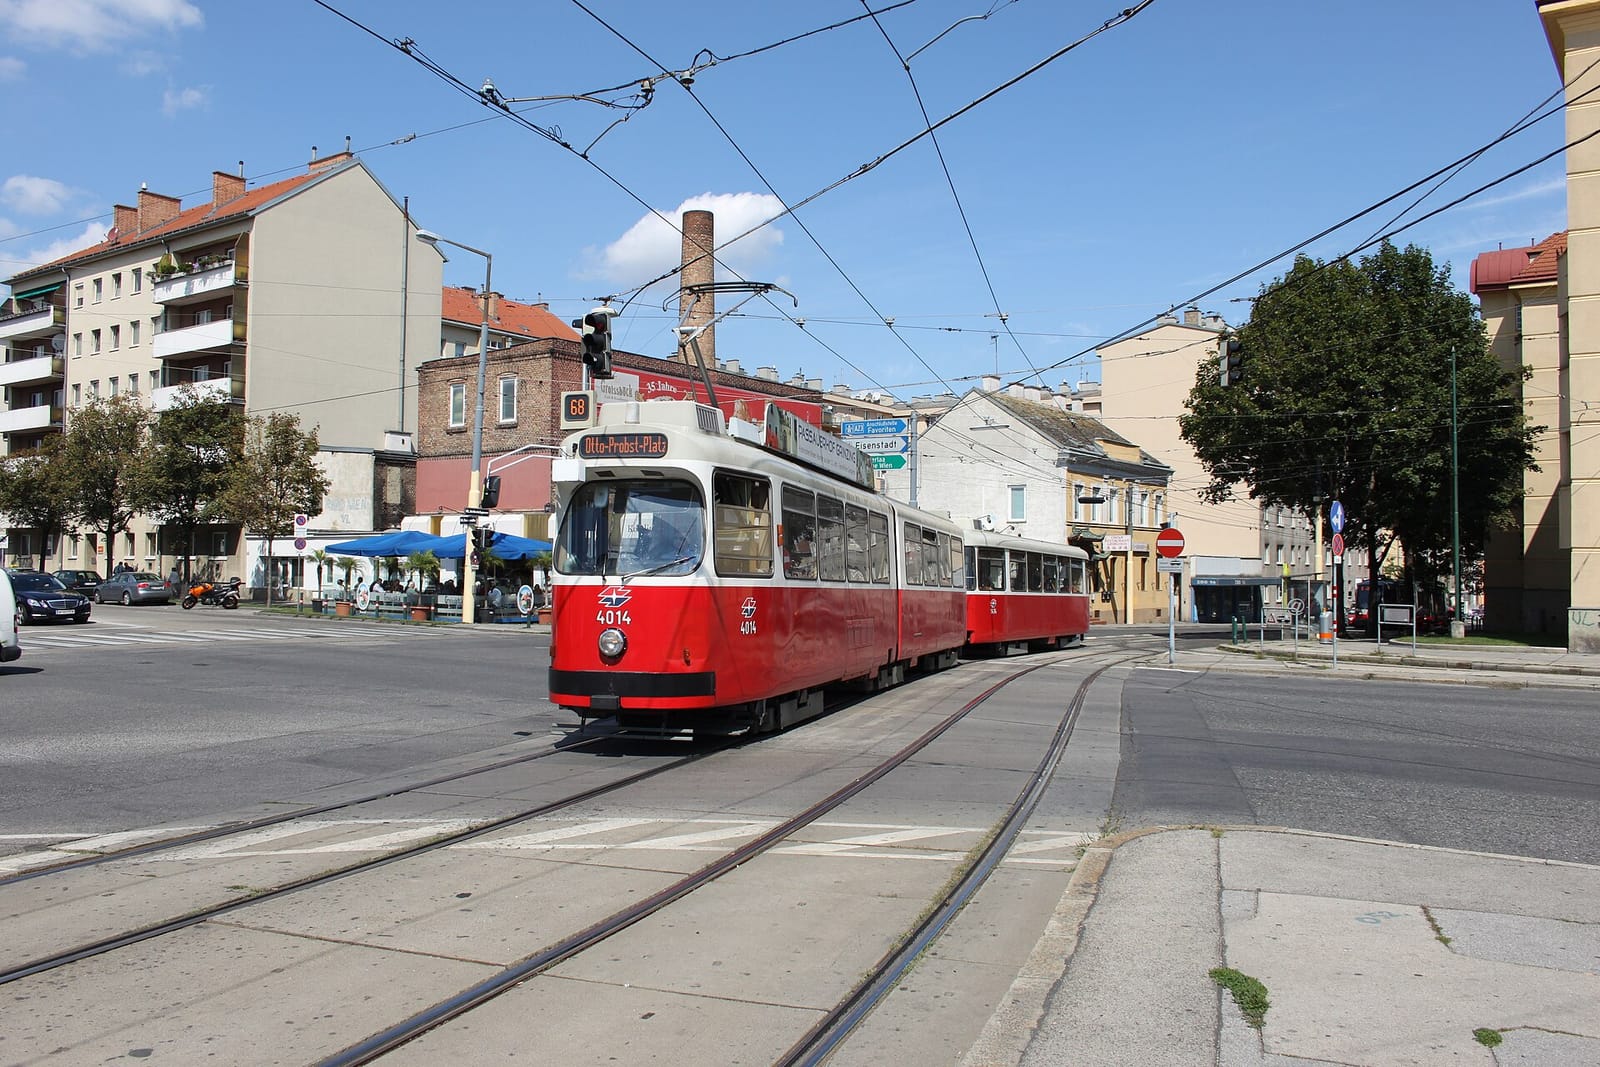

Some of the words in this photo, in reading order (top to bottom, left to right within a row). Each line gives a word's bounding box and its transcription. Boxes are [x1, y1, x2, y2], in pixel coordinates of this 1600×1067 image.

[646, 381, 656, 393] 35
[657, 380, 678, 394] Jahre
[570, 399, 585, 415] 68
[585, 436, 666, 454] Otto-Probst-Platz
[798, 424, 836, 453] PASSAUERHOF
[855, 440, 897, 450] Eisenstadt
[596, 610, 632, 625] 4014
[740, 620, 757, 635] 4014
